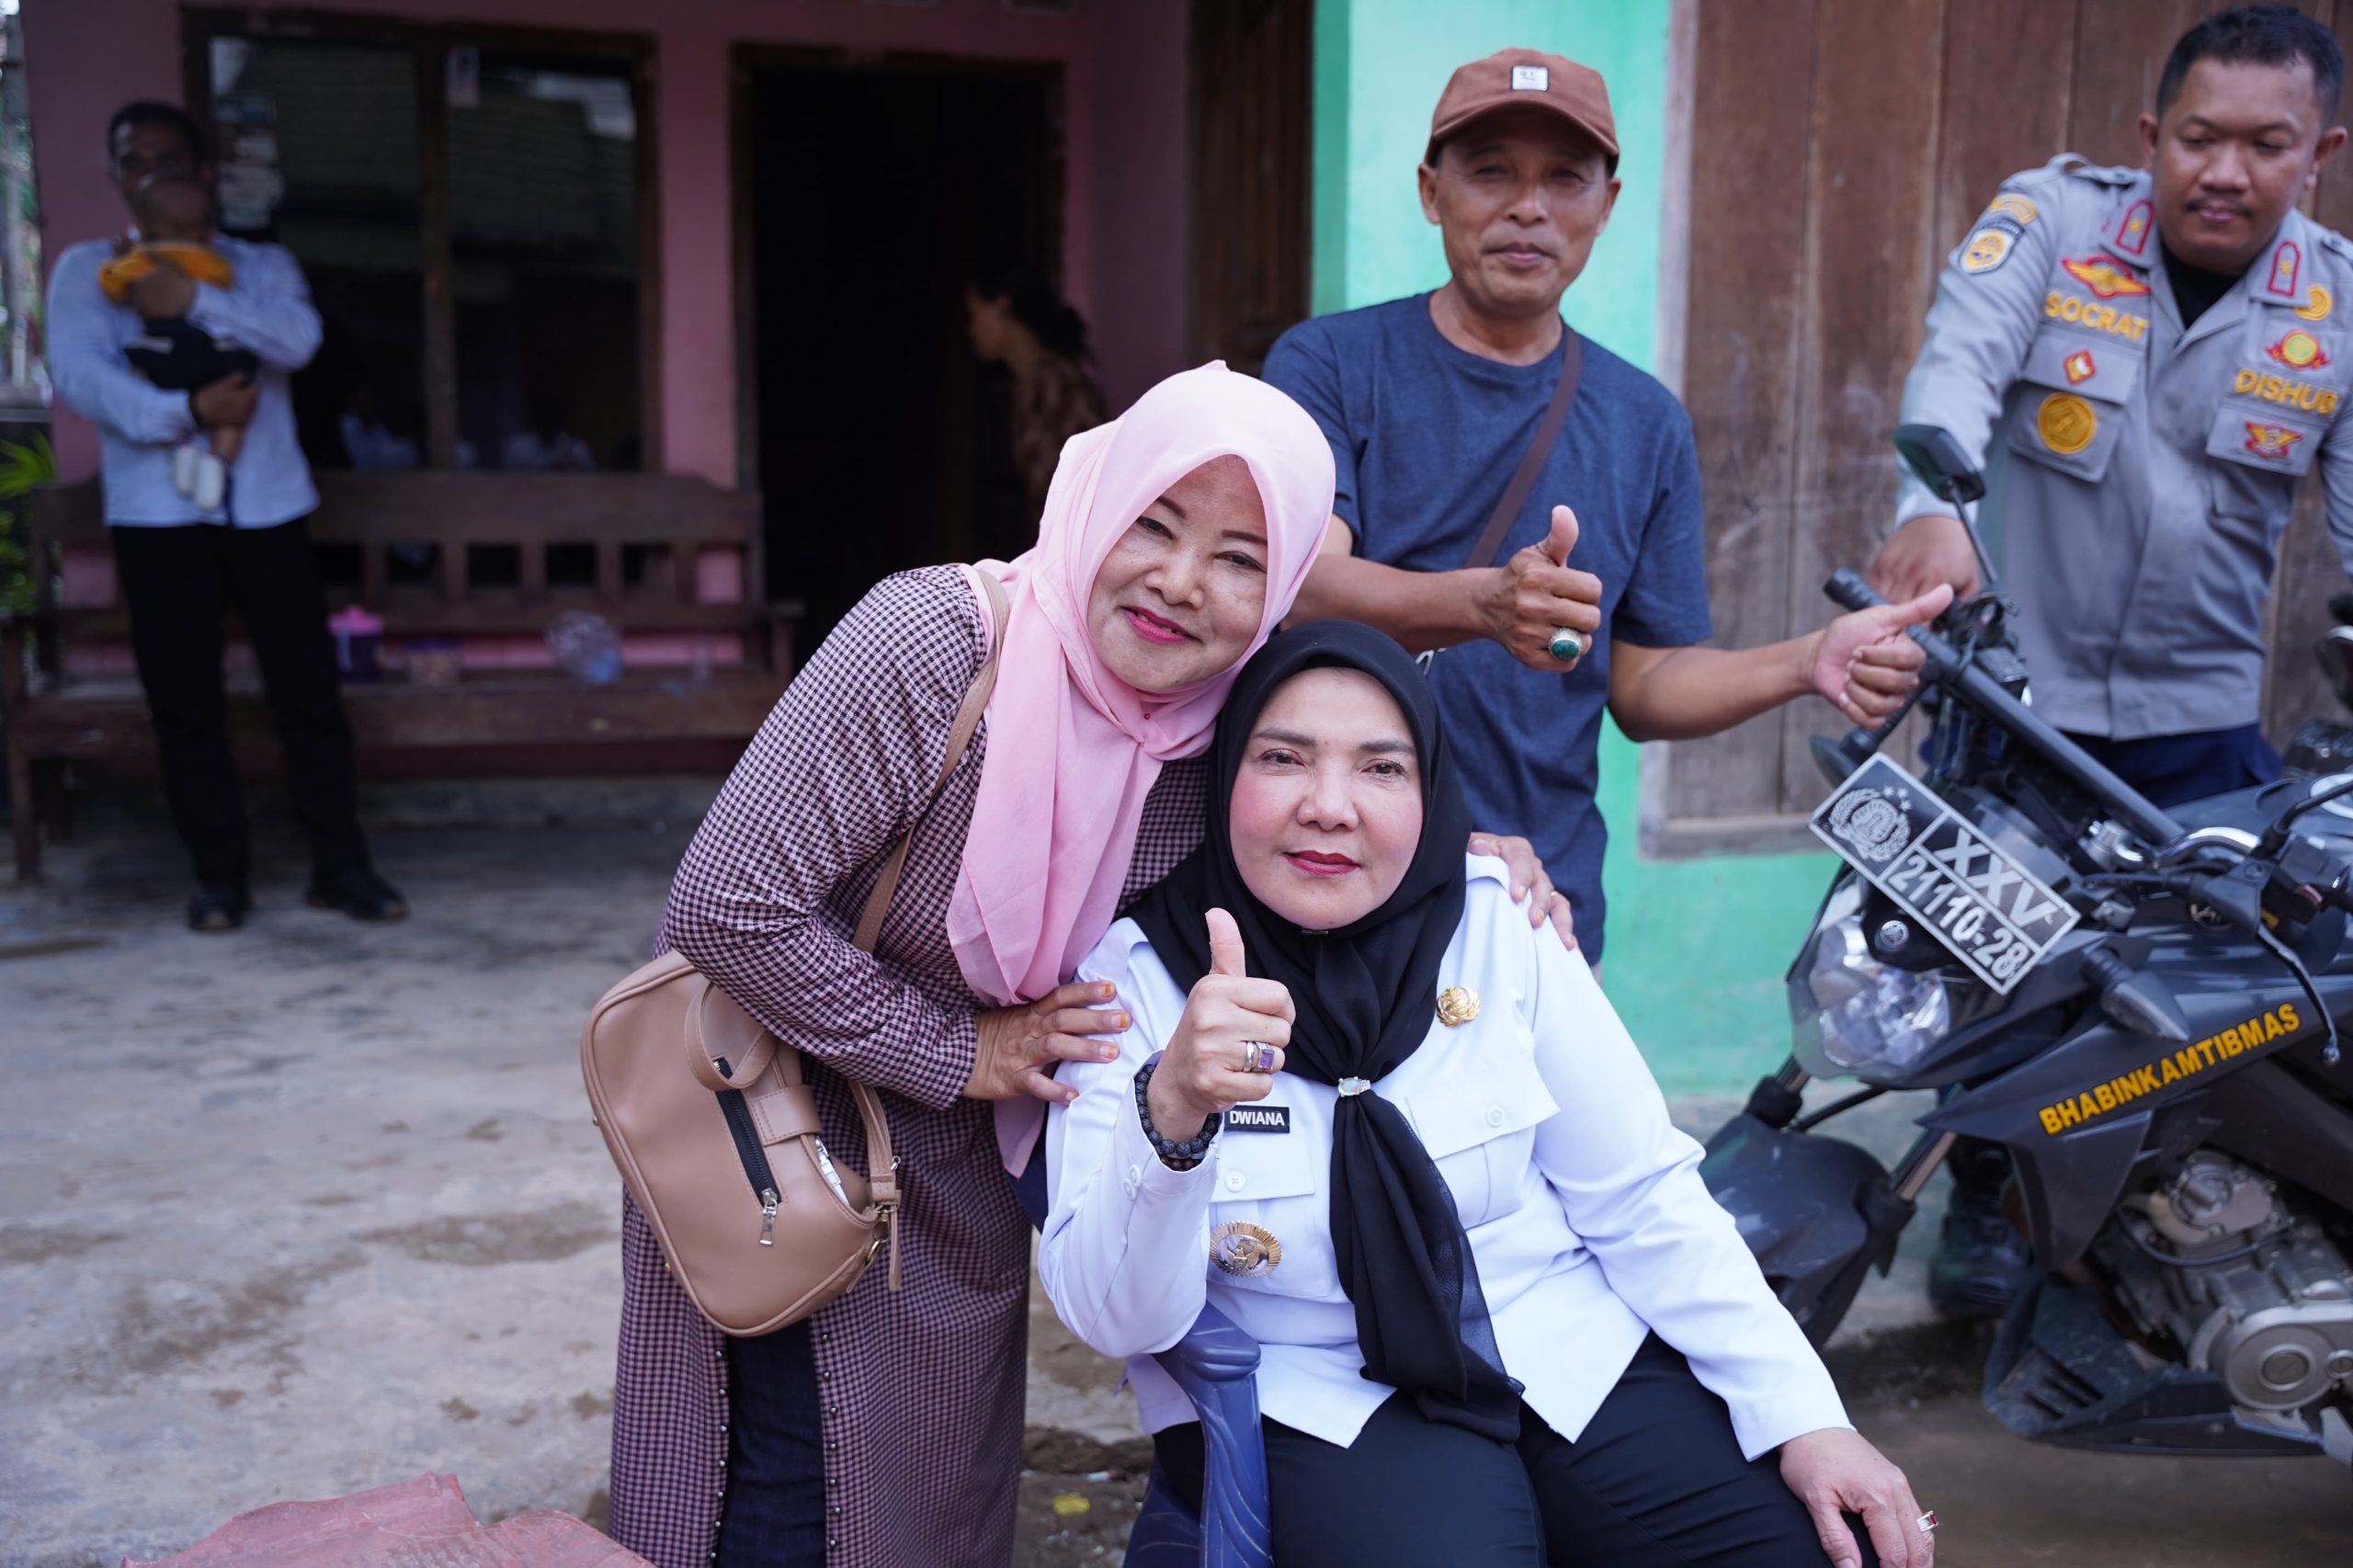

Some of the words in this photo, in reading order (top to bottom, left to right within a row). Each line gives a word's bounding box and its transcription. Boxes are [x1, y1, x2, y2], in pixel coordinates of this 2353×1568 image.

[2044, 291, 2148, 341] SOCRAT
[2234, 369, 2338, 415] DISHUB
[1933, 827, 2059, 927] XXV
[1889, 854, 2029, 980] 21110-28
[2039, 1004, 2300, 1135] BHABINKAMTIBMAS
[1230, 1110, 1285, 1127] DWIANA
